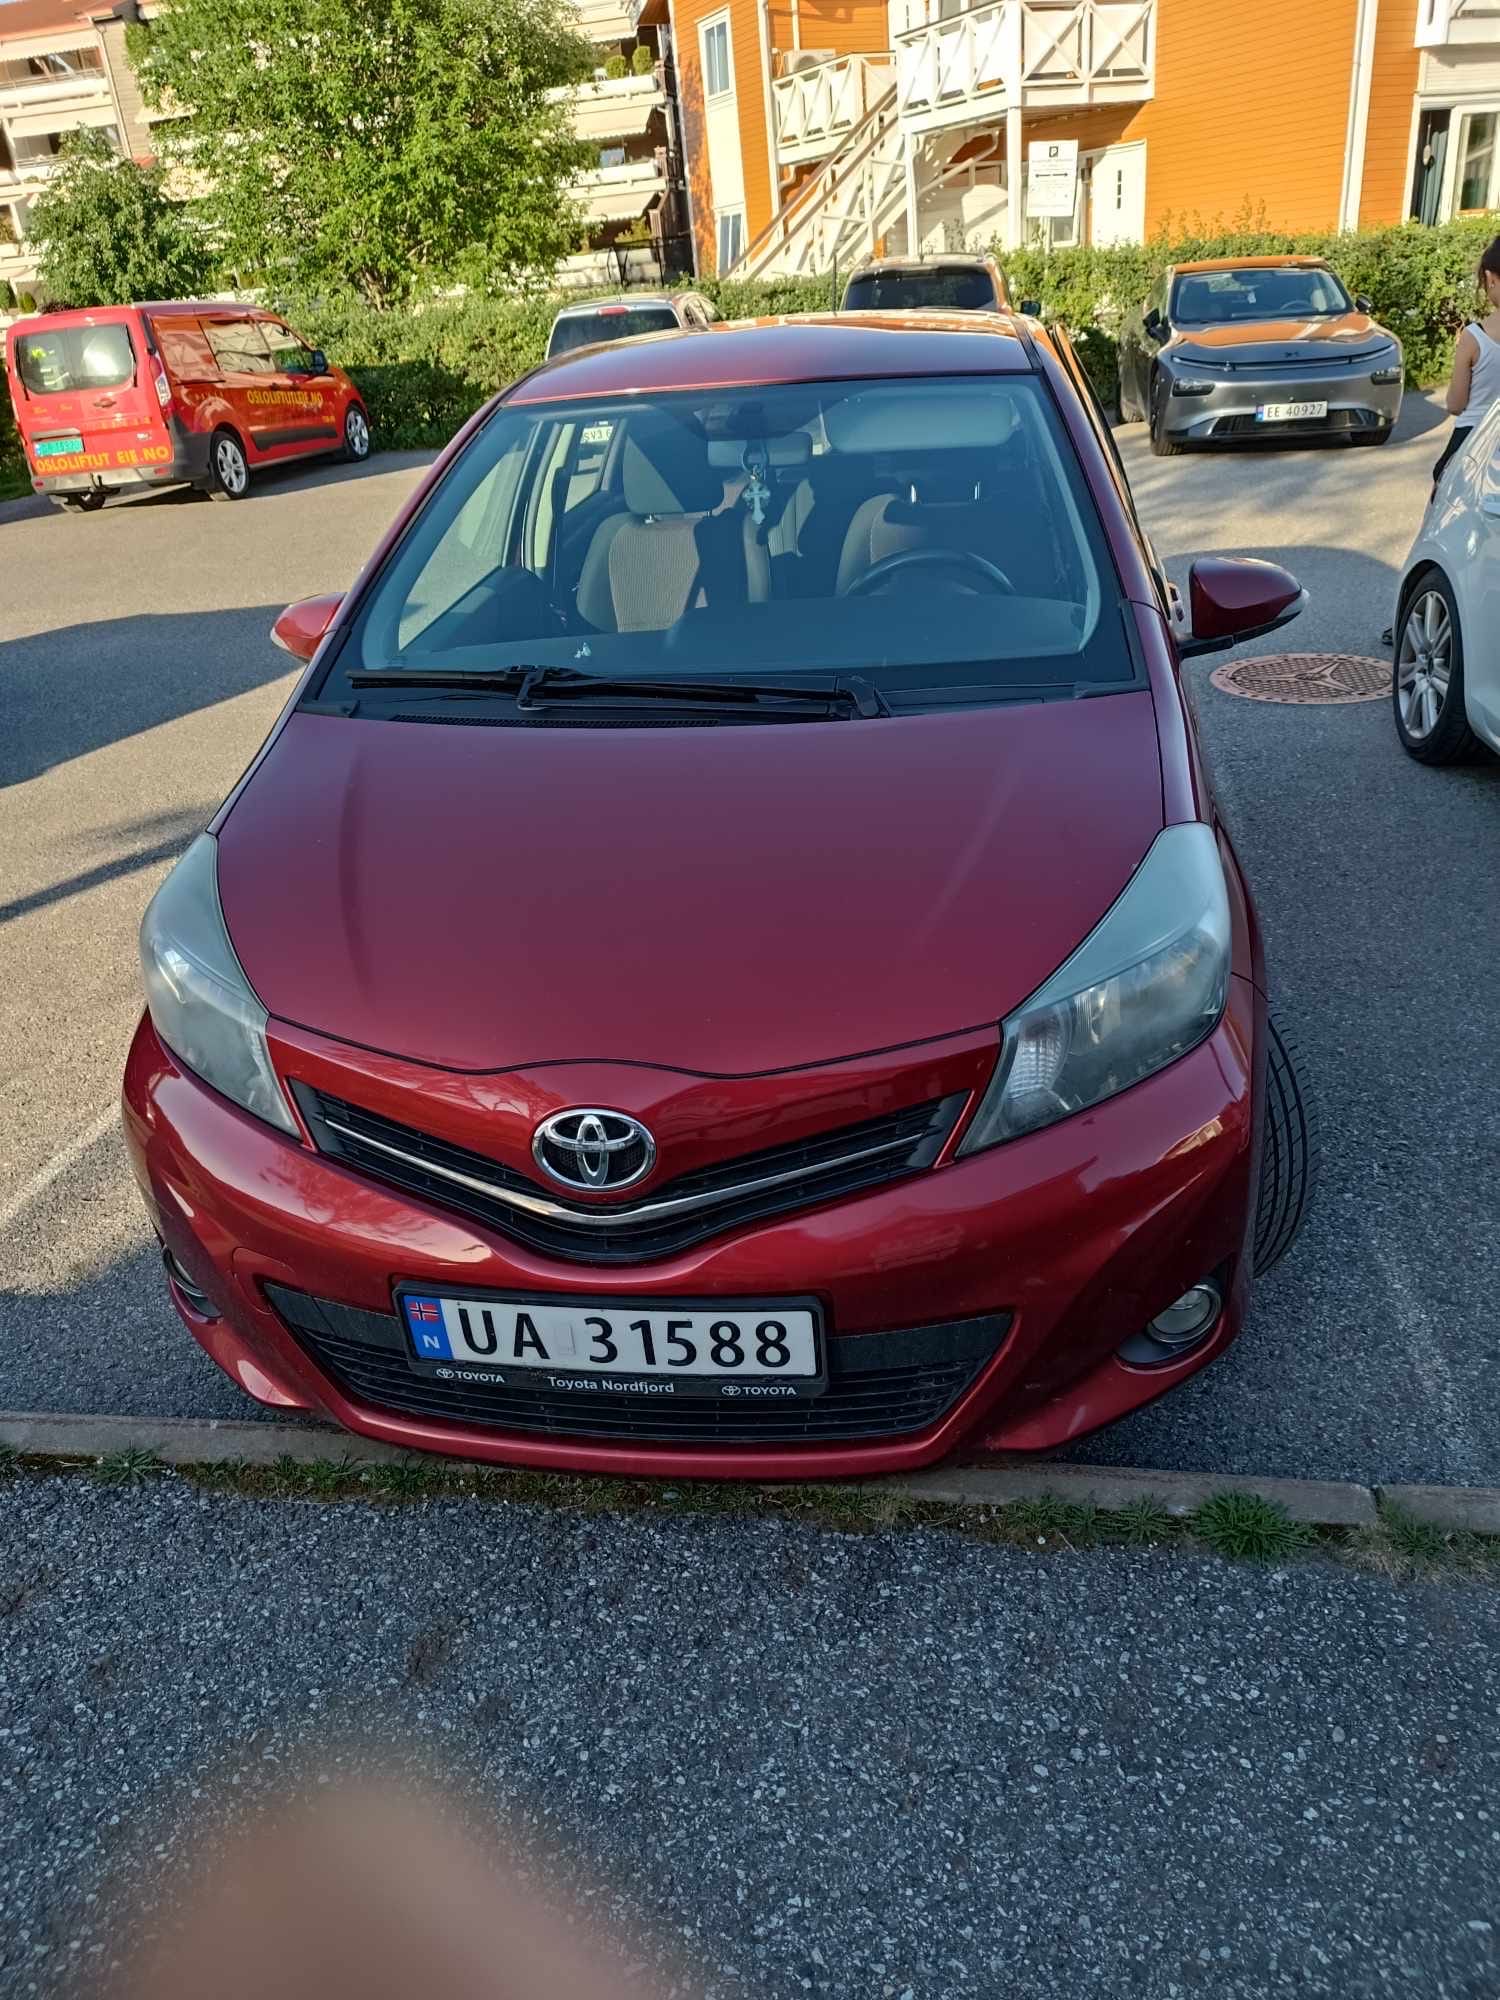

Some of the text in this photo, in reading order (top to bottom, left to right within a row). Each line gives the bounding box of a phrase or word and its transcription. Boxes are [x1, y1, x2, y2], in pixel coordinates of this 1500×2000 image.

[1267, 404, 1323, 418] EE 40927
[423, 1335, 440, 1350] N
[457, 1307, 792, 1369] UA 31588
[454, 1371, 505, 1384] TOYOTA
[547, 1376, 675, 1395] Toyota Nordfjord
[742, 1386, 797, 1396] TOYOTA
